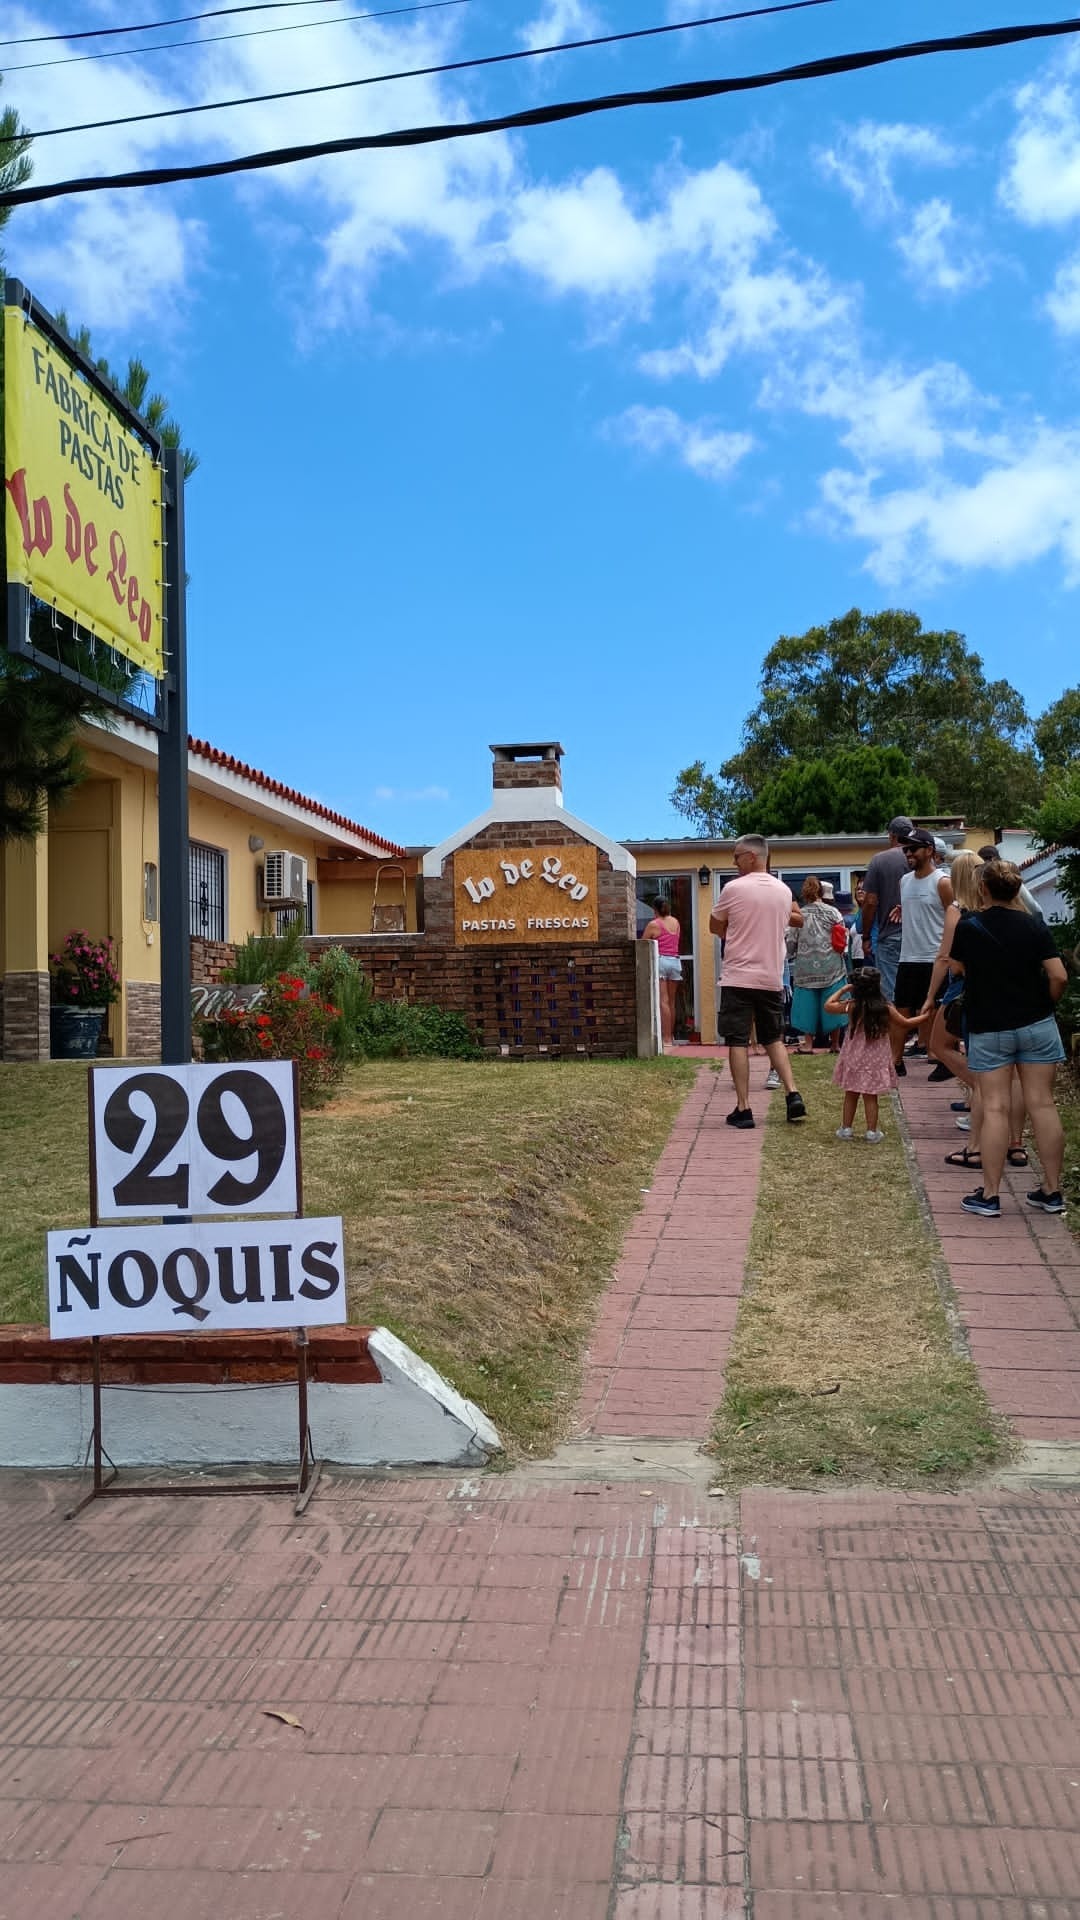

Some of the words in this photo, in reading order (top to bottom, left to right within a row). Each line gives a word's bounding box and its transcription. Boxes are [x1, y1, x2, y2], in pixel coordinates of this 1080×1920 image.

[32, 346, 115, 461] FABRICA
[118, 435, 141, 486] DE
[59, 418, 125, 510] PASTAS
[106, 530, 152, 643] Leo
[462, 918, 517, 931] PASTAS
[527, 916, 590, 930] FRESCAS
[540, 856, 590, 901] Leo
[103, 1069, 287, 1209] 29
[55, 1234, 340, 1323] ÑOQUIS
